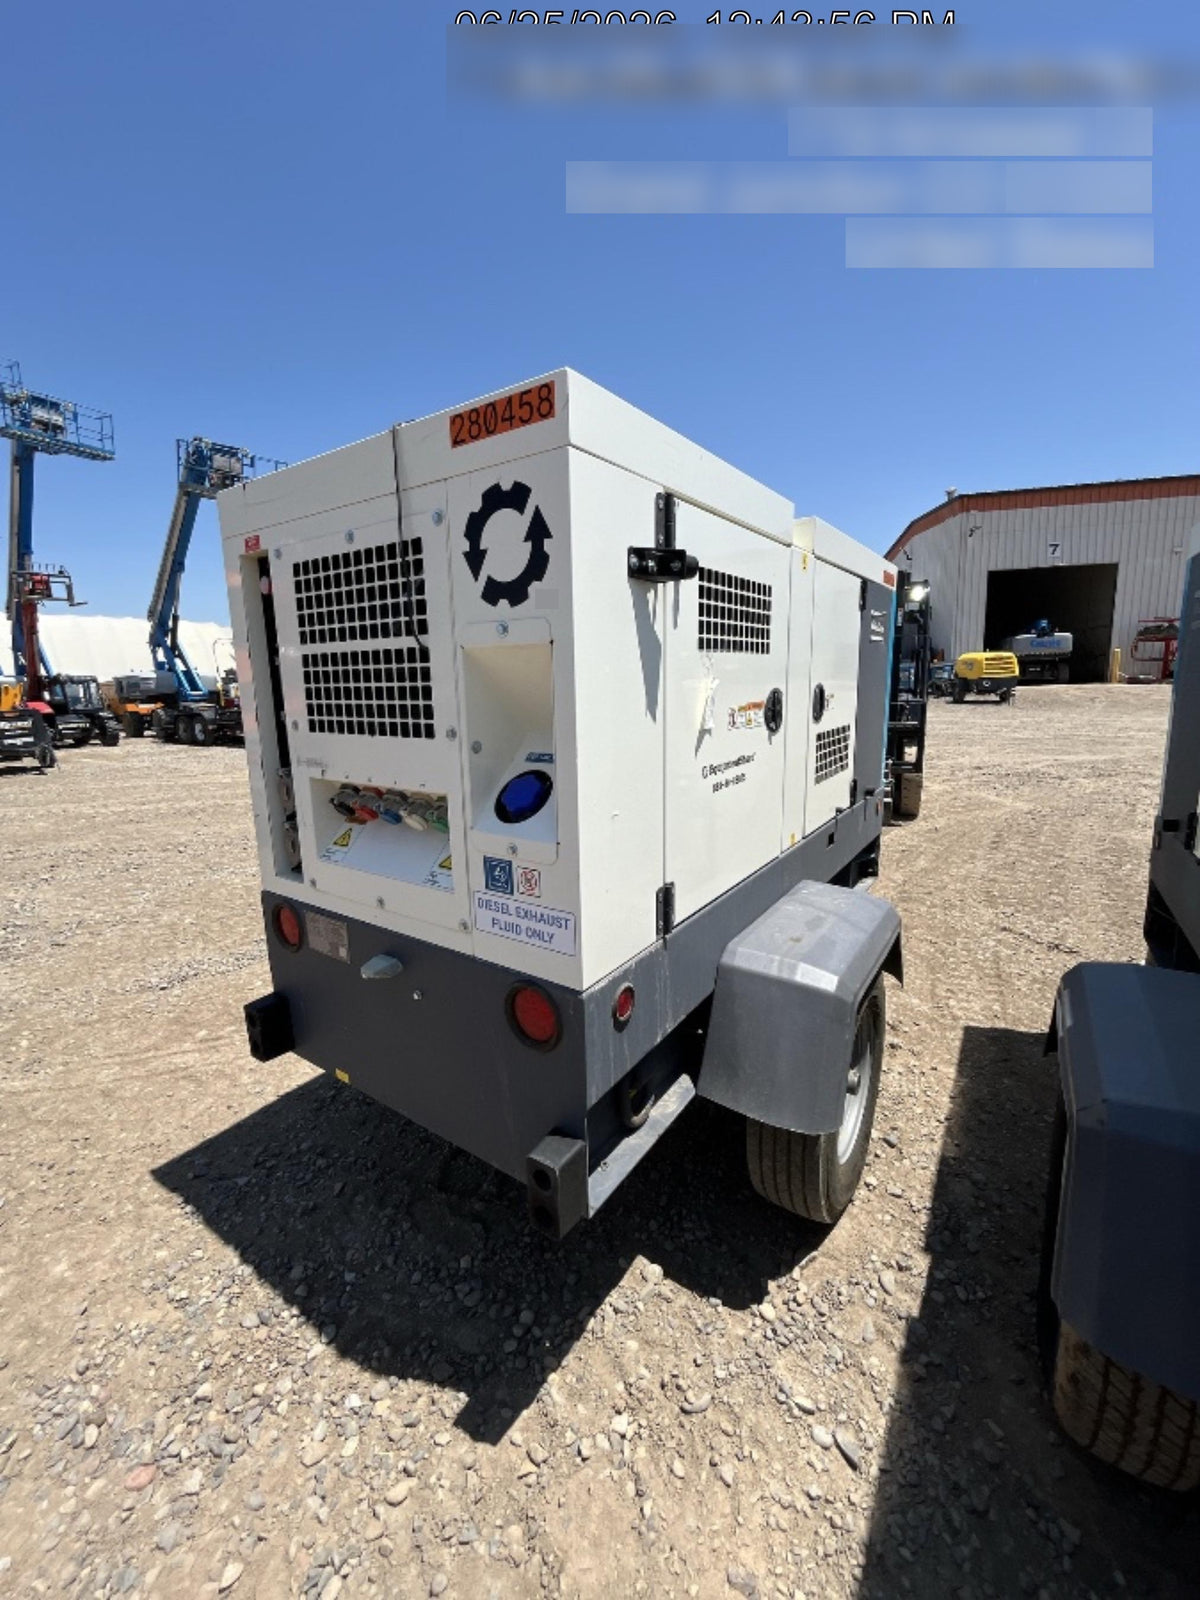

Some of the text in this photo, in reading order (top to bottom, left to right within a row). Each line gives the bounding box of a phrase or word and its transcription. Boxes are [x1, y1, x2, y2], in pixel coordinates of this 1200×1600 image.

[452, 383, 552, 445] 280458
[1049, 543, 1061, 555] 7
[477, 897, 571, 930] DIESEL EXHAUST
[492, 917, 555, 944] FLUID ONLY
